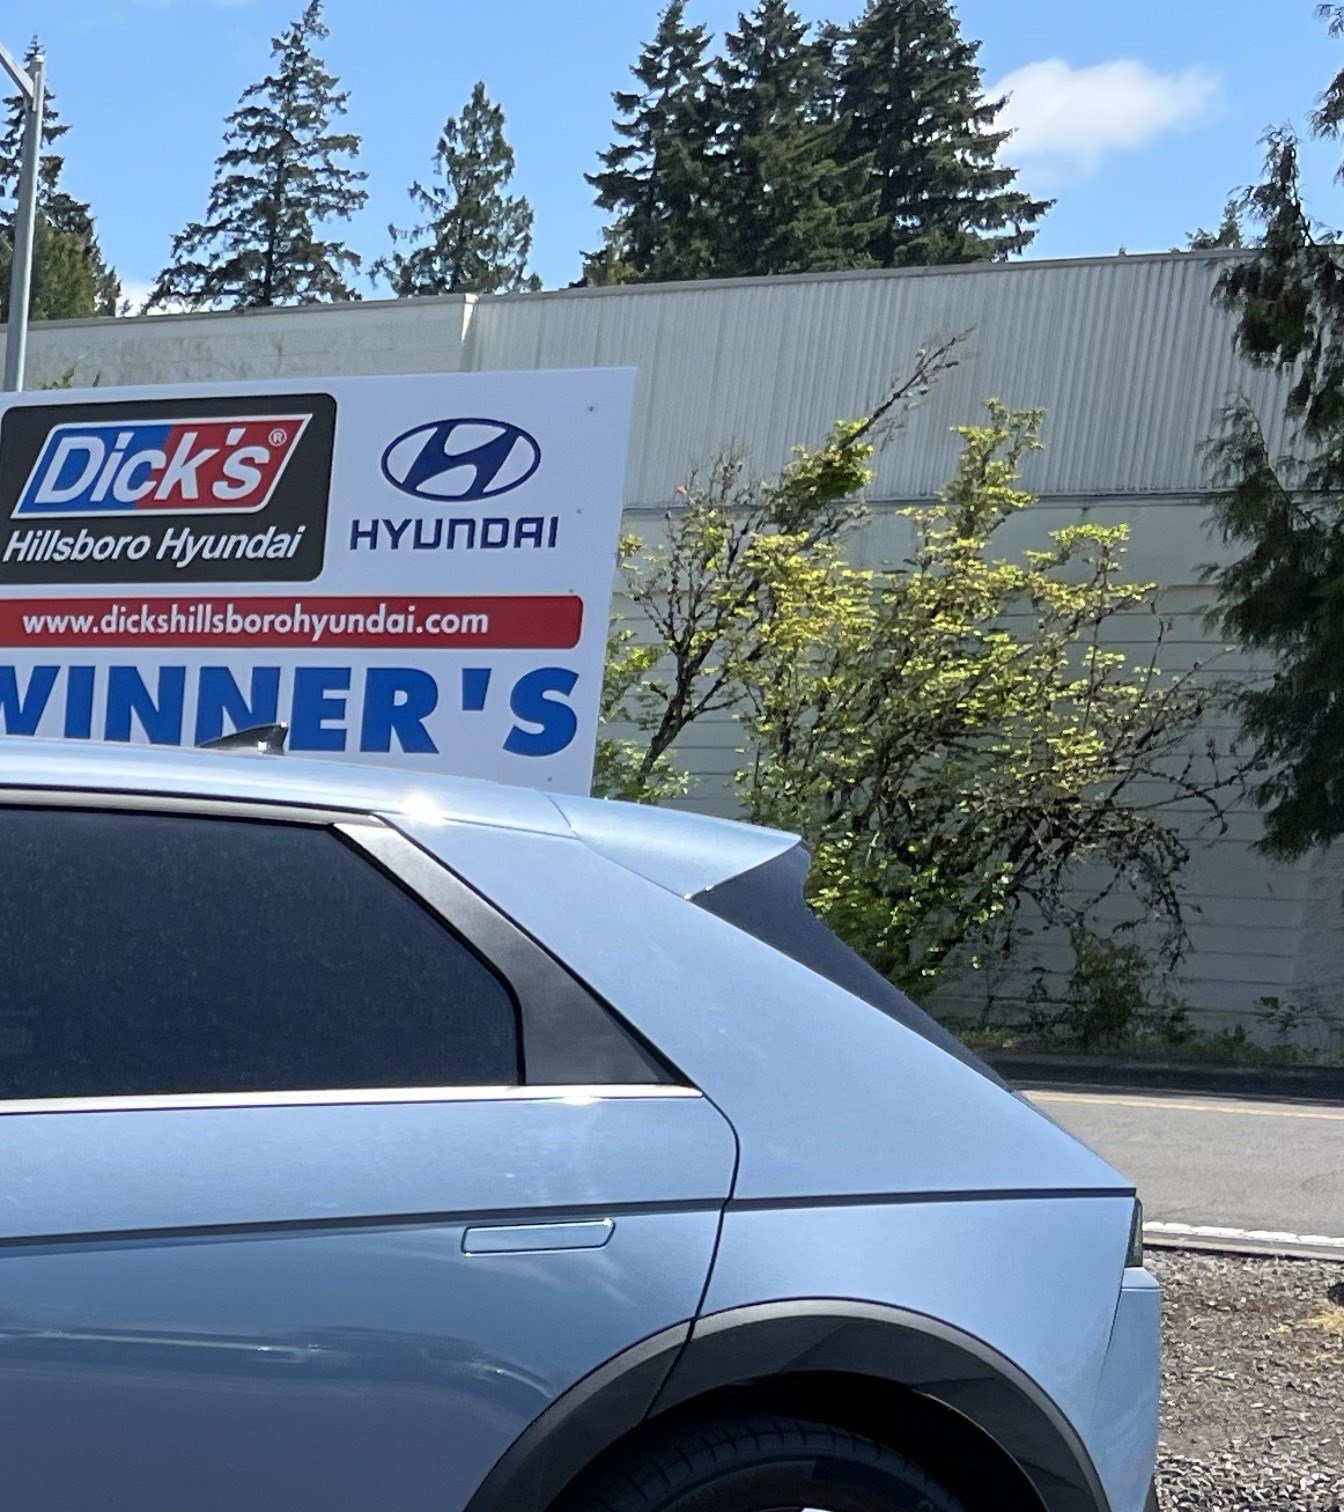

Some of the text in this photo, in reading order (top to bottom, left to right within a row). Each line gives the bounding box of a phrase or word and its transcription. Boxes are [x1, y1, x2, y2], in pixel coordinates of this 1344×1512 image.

[2, 525, 305, 568] Hillsboro Hyundai
[349, 516, 559, 551] HYUNDAI
[21, 603, 490, 641] www.dickshillsborohyundai.com
